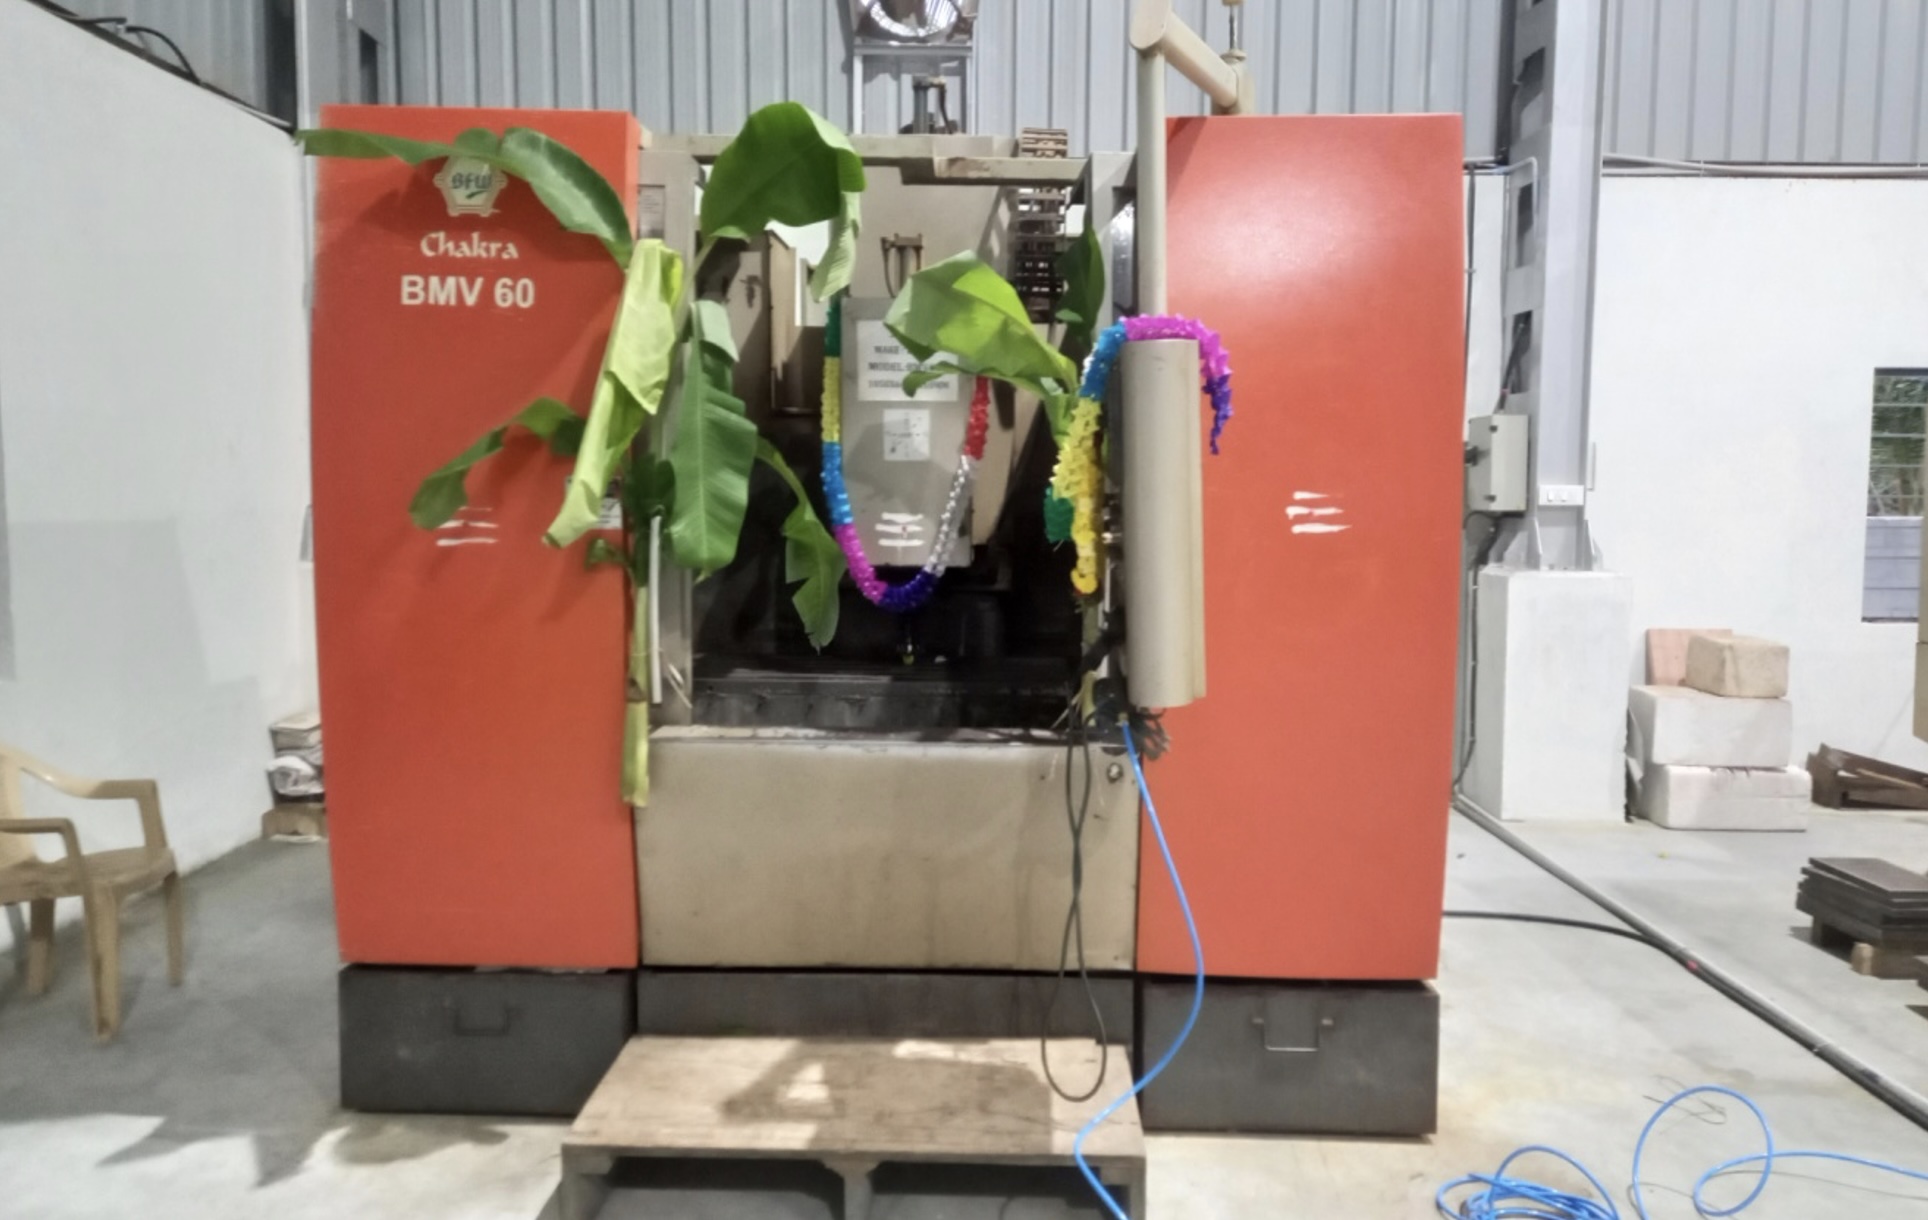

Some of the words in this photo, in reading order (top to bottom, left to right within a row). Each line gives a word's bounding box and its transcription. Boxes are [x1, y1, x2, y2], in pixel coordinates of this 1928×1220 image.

[451, 172, 491, 190] BFW
[420, 231, 519, 259] Chakra
[401, 274, 483, 306] BMV
[494, 277, 535, 309] 60
